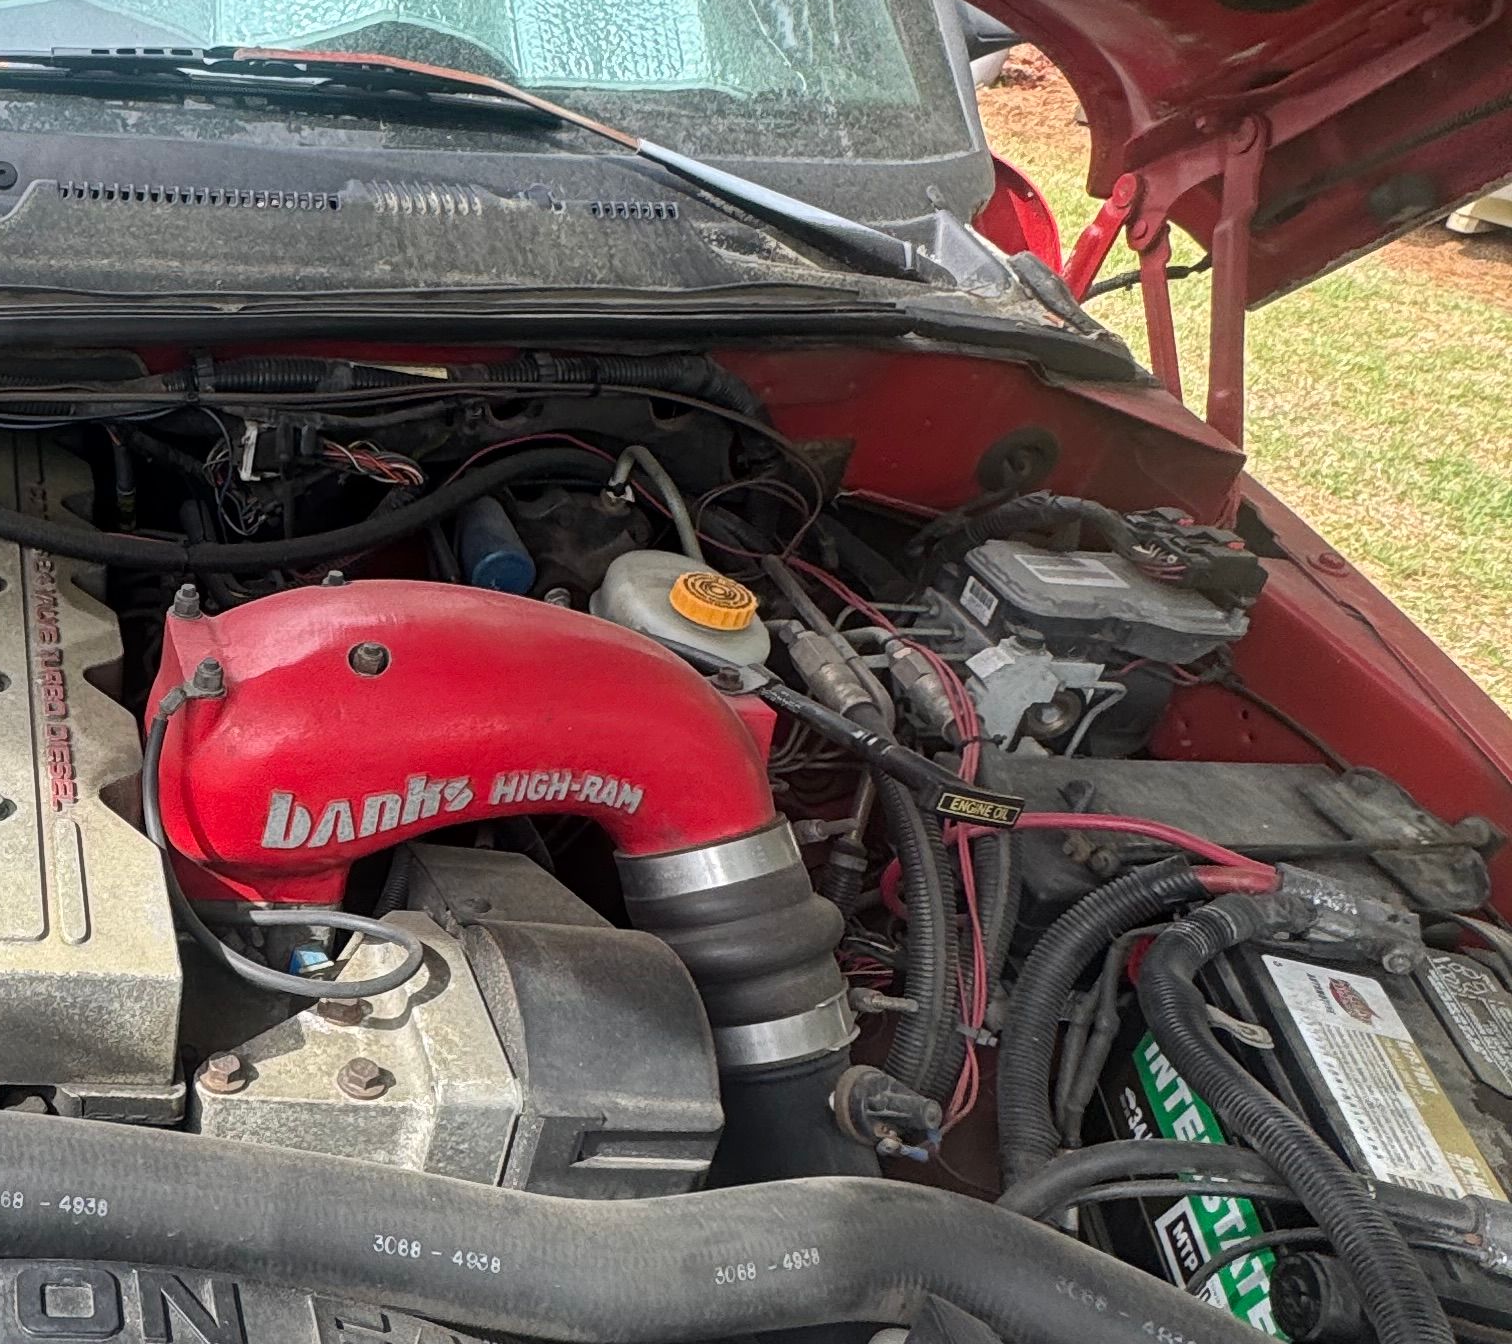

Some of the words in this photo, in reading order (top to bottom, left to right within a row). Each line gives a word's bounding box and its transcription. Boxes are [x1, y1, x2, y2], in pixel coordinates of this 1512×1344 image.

[35, 587, 61, 645] VALVE
[37, 647, 68, 720] TURBO
[45, 722, 77, 813] DIESEL
[261, 773, 475, 850] banks
[489, 769, 645, 815] HIGH-RAM
[949, 798, 994, 819] ENGINE
[991, 807, 1010, 822] OIL
[58, 1194, 109, 1218] 4938
[1143, 1040, 1278, 1336] INTESTATE
[451, 1249, 502, 1274] 4938
[714, 1261, 757, 1285] 3068
[782, 1247, 821, 1271] 4938
[1171, 1220, 1199, 1273] MTP
